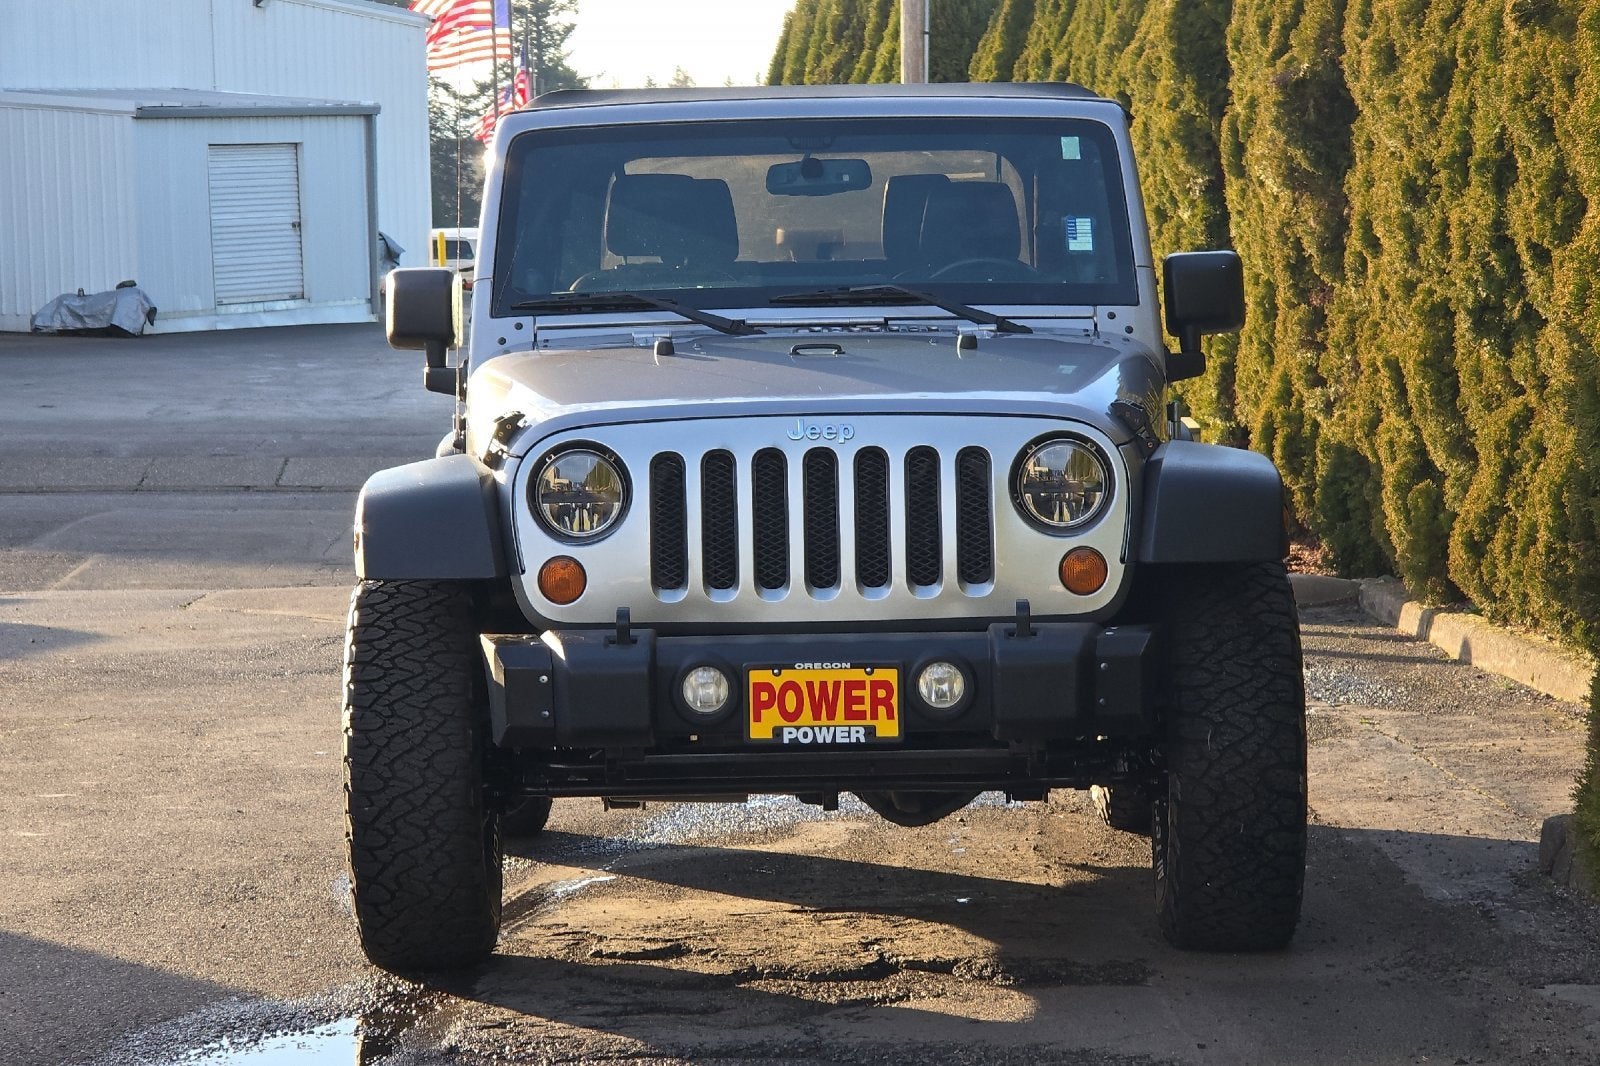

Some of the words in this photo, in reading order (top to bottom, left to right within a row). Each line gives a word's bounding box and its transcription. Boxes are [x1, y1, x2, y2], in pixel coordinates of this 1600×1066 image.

[786, 419, 855, 444] Jeep
[794, 662, 851, 670] OREGON
[752, 680, 896, 722] POWER
[783, 726, 866, 744] POWER
